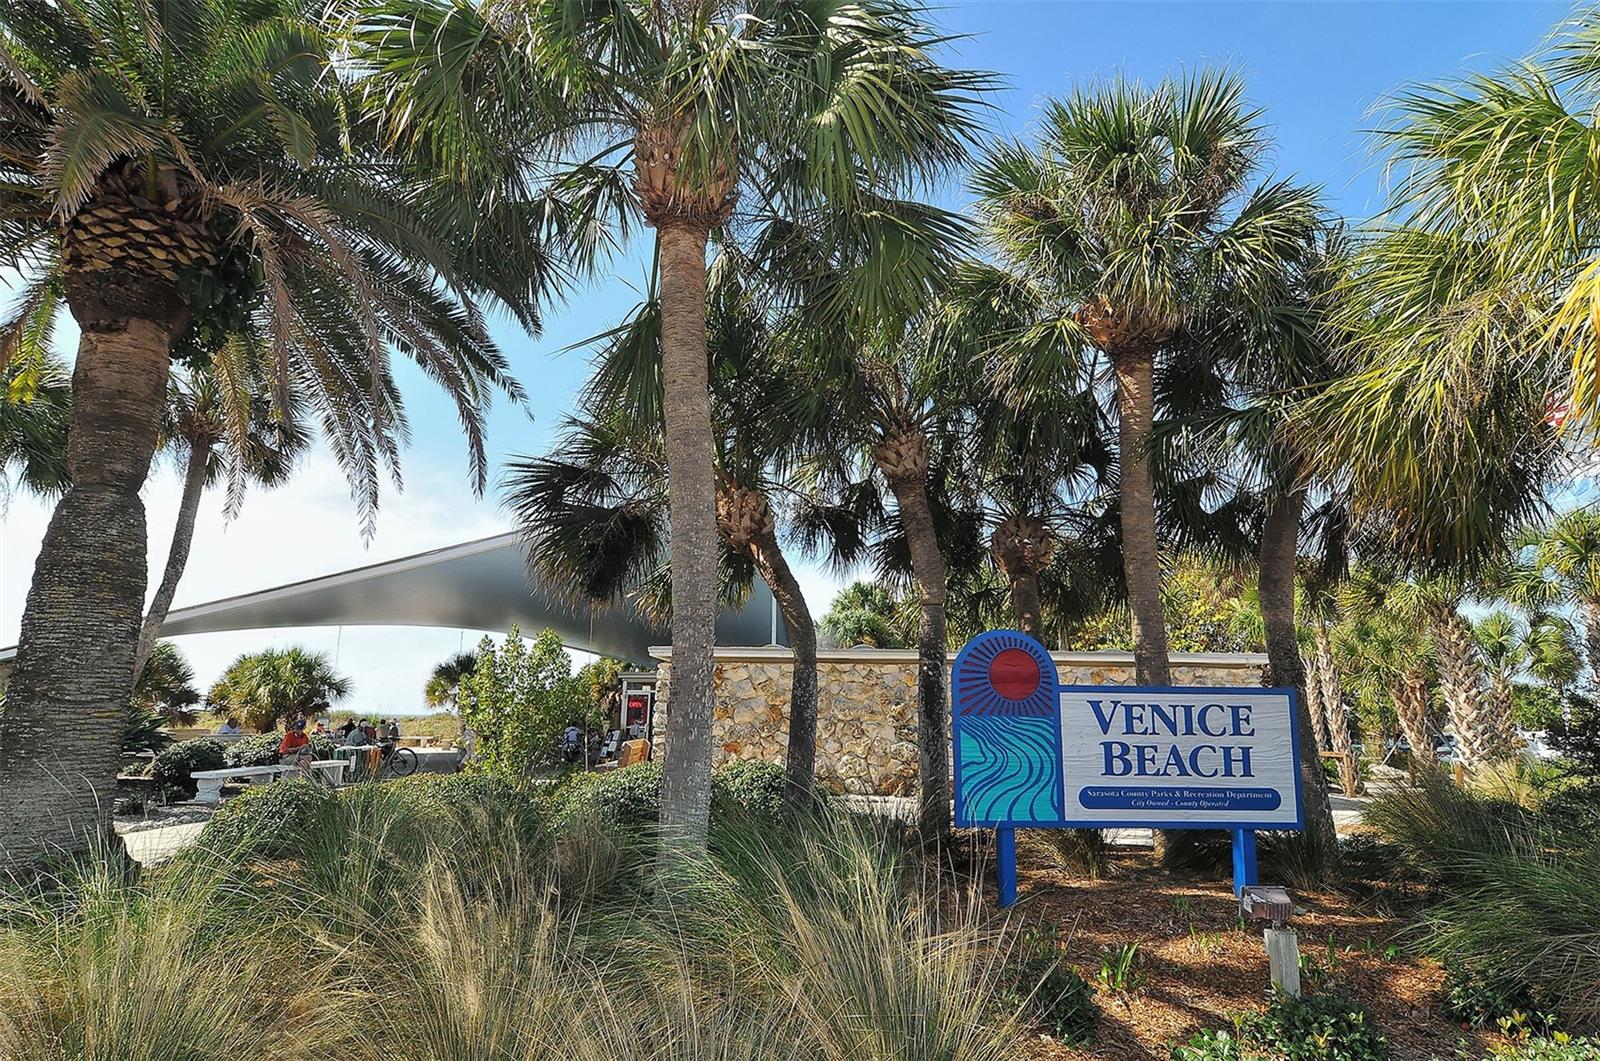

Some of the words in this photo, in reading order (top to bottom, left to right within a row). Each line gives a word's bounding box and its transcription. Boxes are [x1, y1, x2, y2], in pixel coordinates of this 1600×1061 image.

[1087, 700, 1256, 737] VENICE
[1100, 741, 1255, 778] BEACH
[1121, 790, 1149, 798] County
[1226, 791, 1273, 799] Department
[1175, 800, 1198, 808] County
[1199, 800, 1230, 808] Operated
